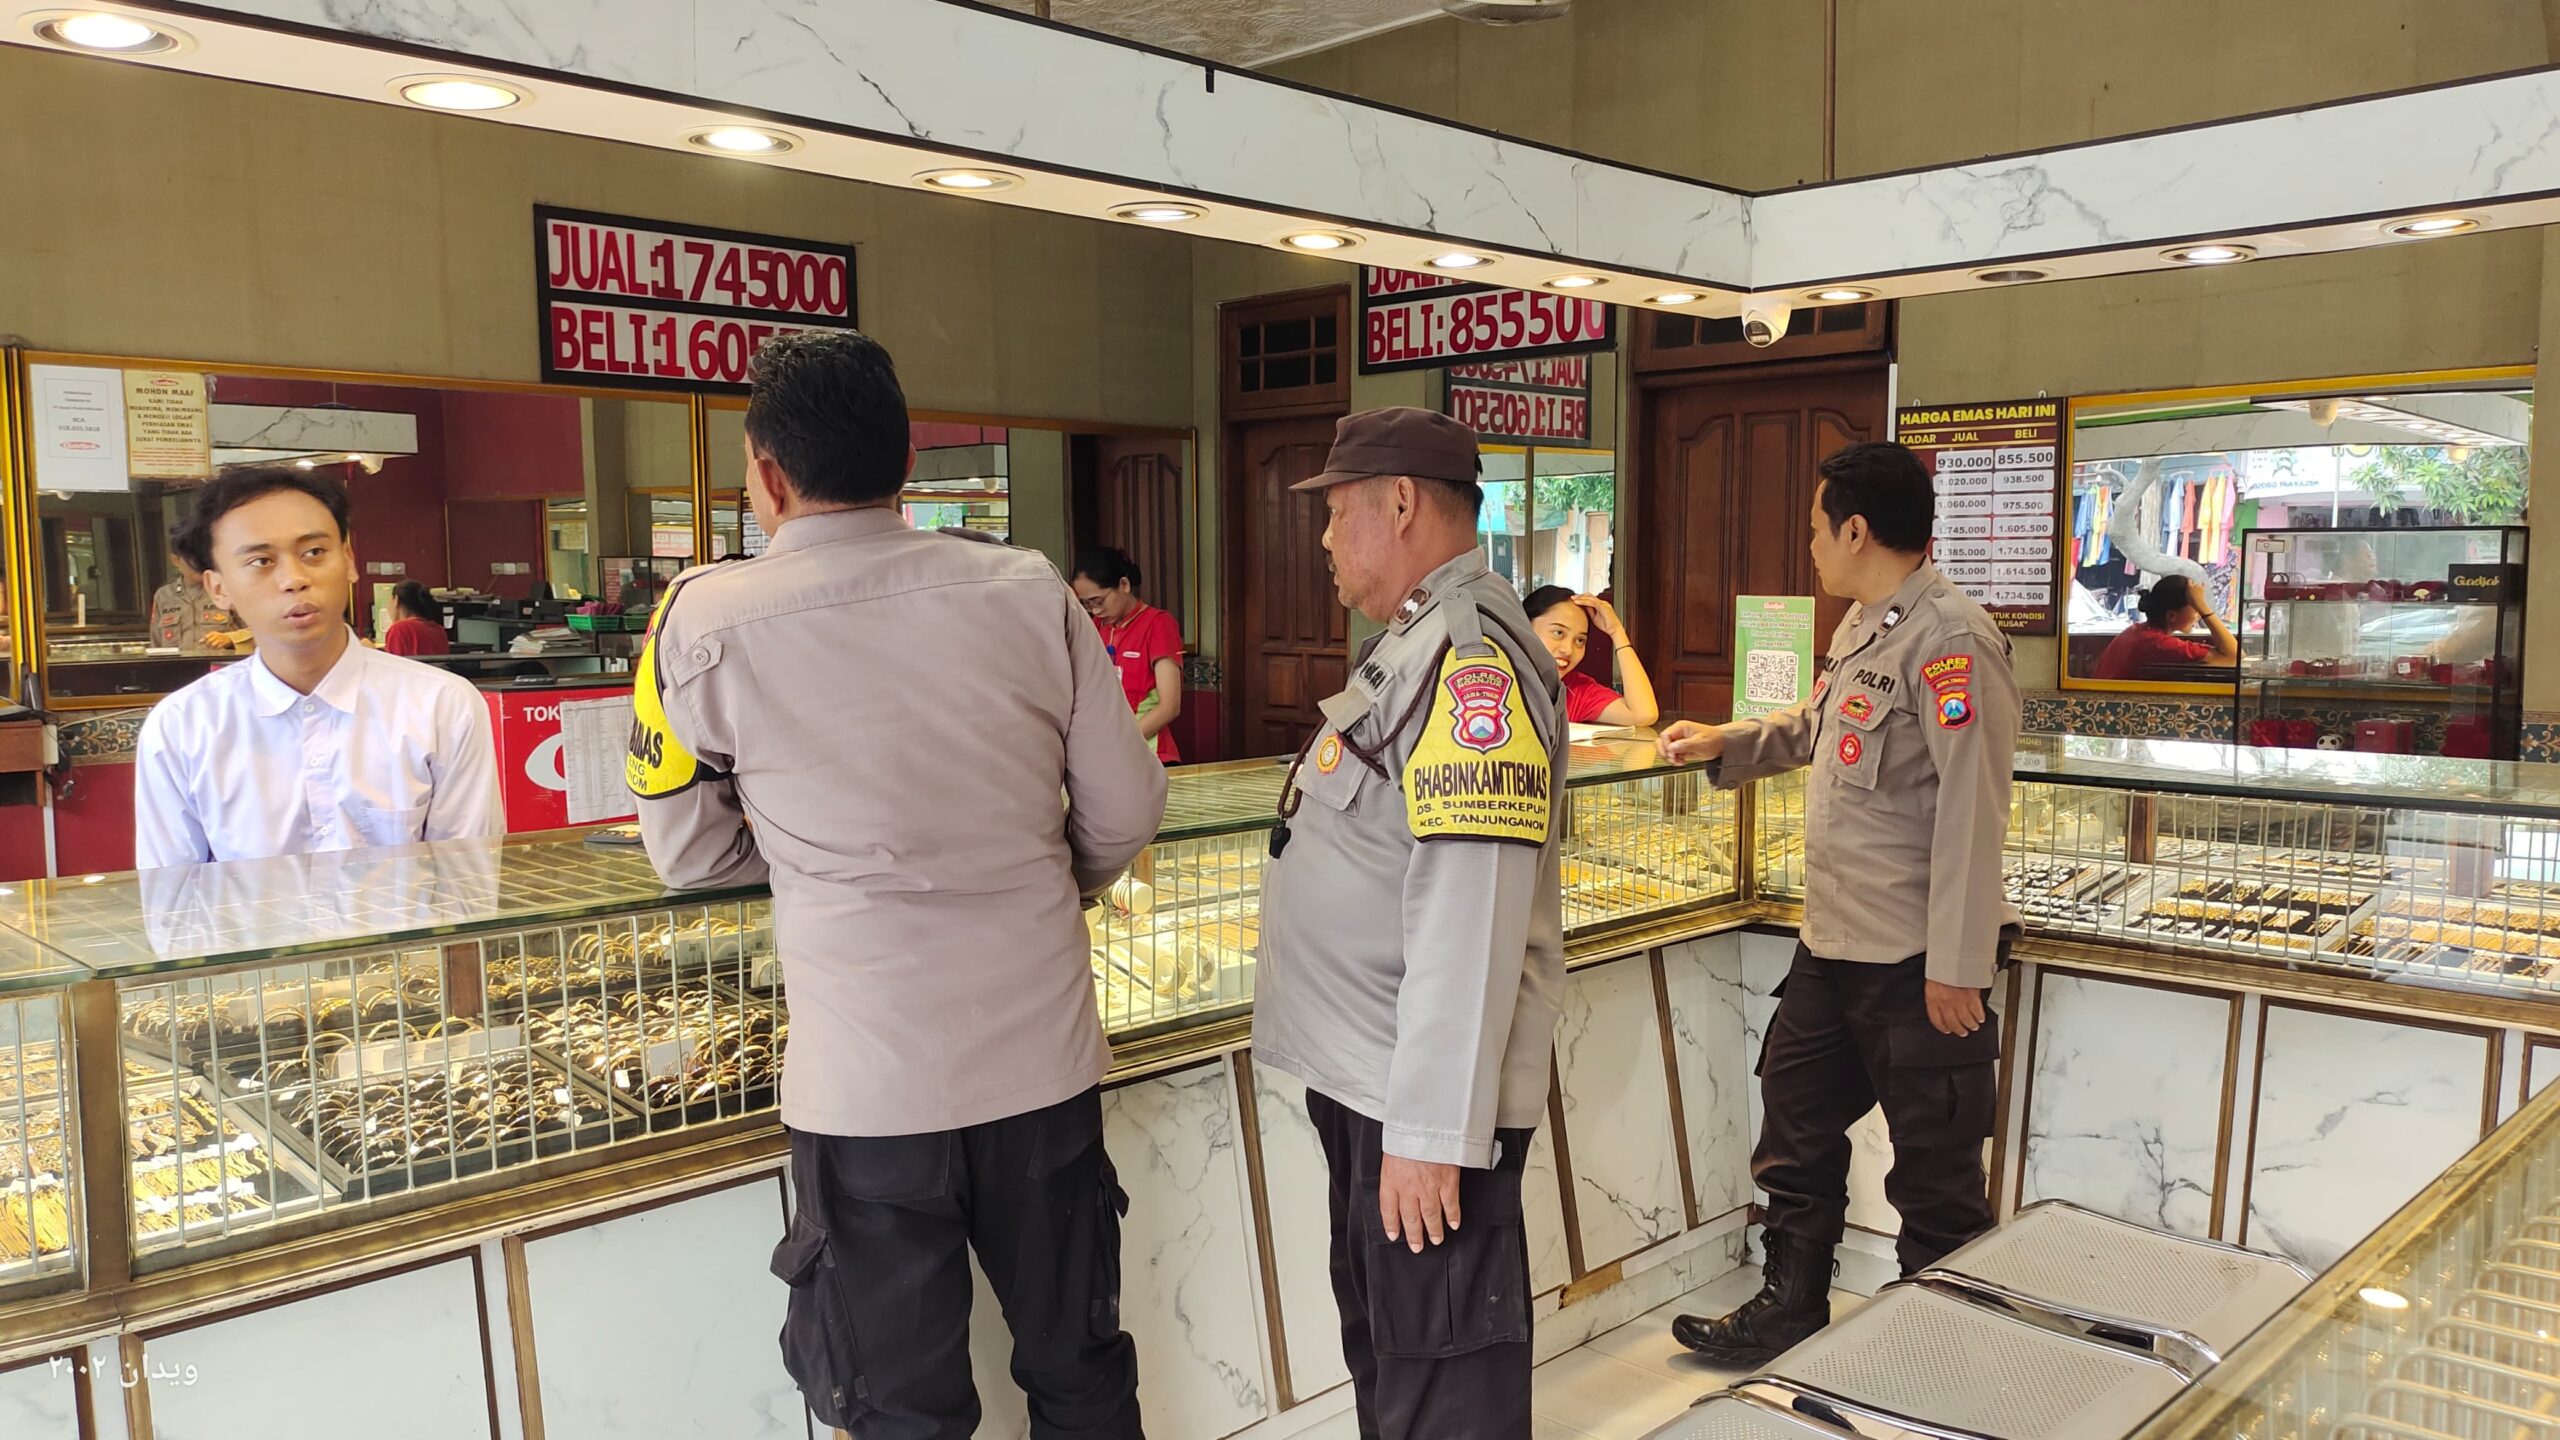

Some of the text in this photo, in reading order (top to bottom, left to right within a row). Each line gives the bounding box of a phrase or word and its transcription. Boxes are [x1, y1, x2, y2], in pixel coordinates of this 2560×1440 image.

[1900, 404, 2057, 426] HARGA EMAS HARI INI
[1899, 429, 2037, 446] KADAR JUAL BELI
[1937, 451, 2054, 469] 930.000 855.500
[2003, 474, 2045, 484] 938.500
[2002, 501, 2044, 510] 975.500
[1998, 524, 2049, 533] 1.605.500
[1998, 547, 2048, 556] 1.743.500
[1996, 567, 2047, 576] 1.614.500
[1994, 591, 2045, 601] 1.734.500
[2011, 611, 2046, 621] KONDISI
[1924, 657, 1968, 674] POLRES
[1852, 668, 1896, 695] POLRI
[523, 706, 561, 723] TOK
[1414, 762, 1547, 800] BHABINKAMTIBMAS
[1442, 800, 1546, 815] SUMBERKEPUH
[1419, 814, 1545, 831] KEC. TANJUNGANOM
